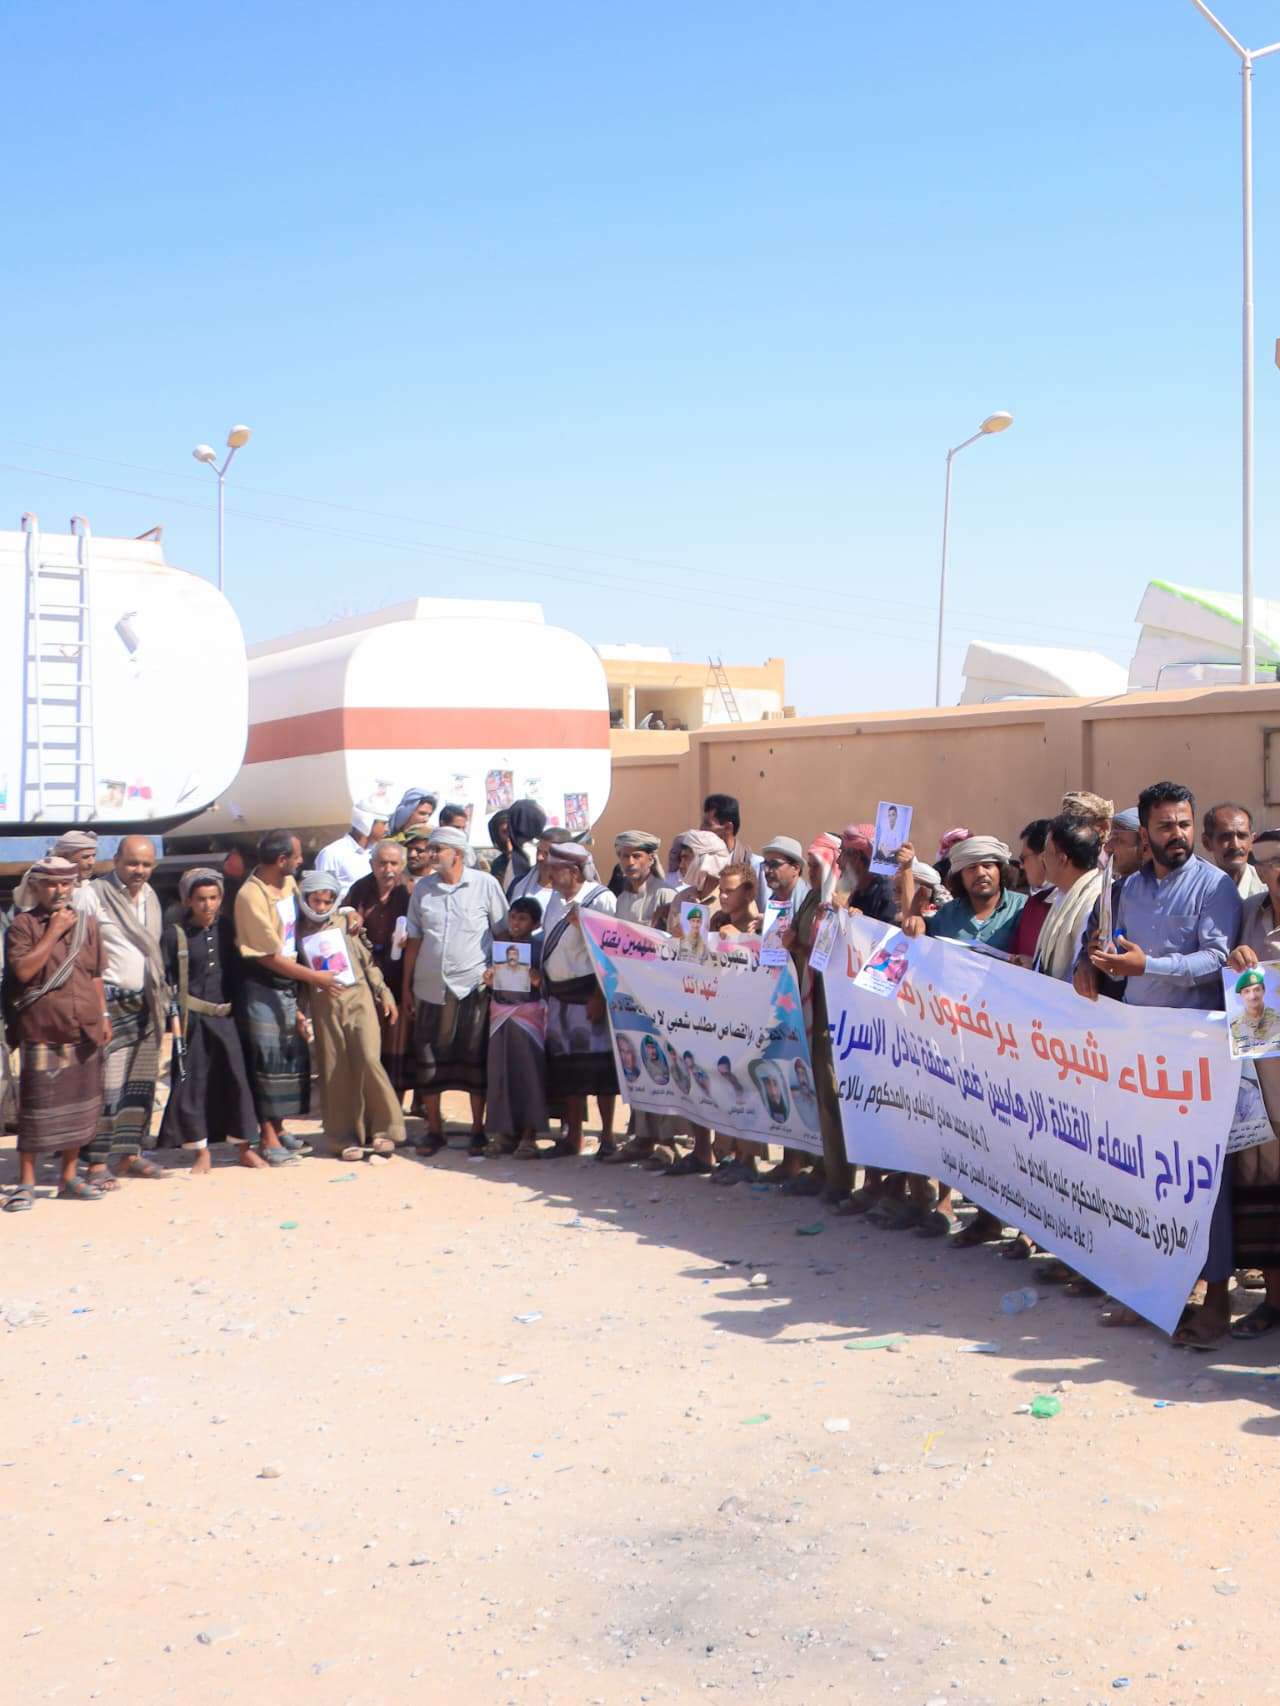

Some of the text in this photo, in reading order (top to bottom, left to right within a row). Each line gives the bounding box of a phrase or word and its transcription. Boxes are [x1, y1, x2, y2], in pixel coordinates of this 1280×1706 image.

[929, 983, 1020, 1061] يرفضون
[1031, 1018, 1109, 1086] شبوة
[837, 1073, 864, 1109] بالاع
[1118, 1052, 1213, 1115] ابناء
[1049, 1096, 1092, 1155] القتلة
[1097, 1120, 1145, 1179] اسماء
